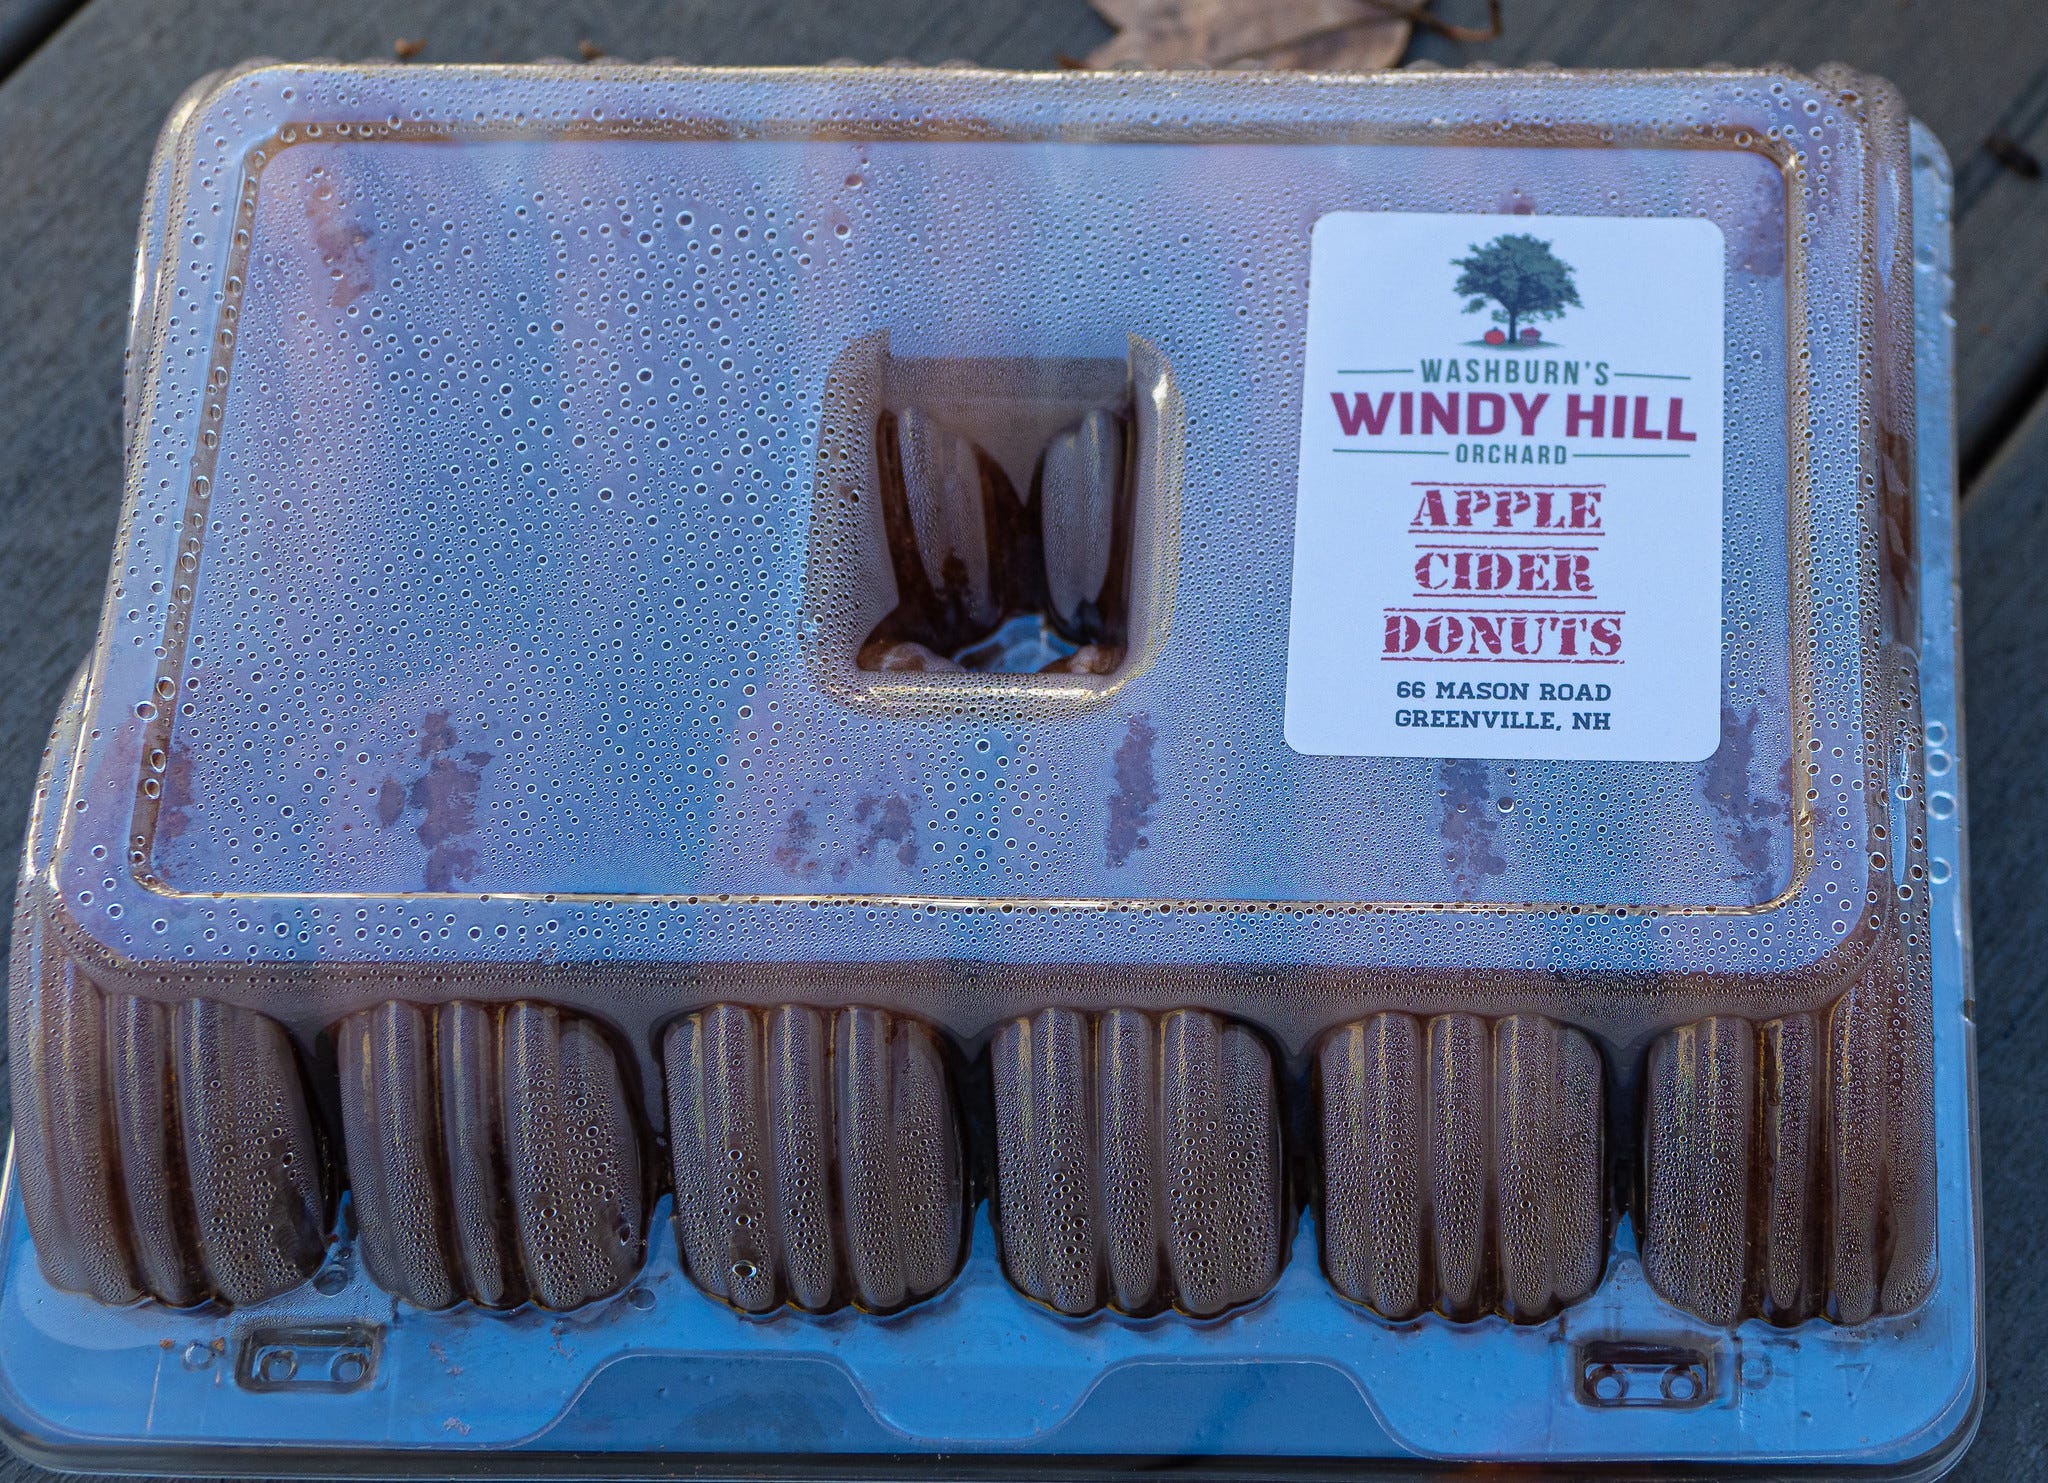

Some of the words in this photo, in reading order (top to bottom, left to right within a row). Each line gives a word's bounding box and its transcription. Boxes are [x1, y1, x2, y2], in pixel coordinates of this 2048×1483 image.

[1420, 358, 1610, 386] WASHBURN'S
[1330, 391, 1550, 436] WINDY
[1565, 393, 1697, 442] HILL
[1456, 443, 1568, 465] ORCHARD
[1410, 489, 1602, 528] APPLE
[1414, 552, 1595, 592] CIDER
[1382, 614, 1622, 656] DONUTS
[1396, 681, 1426, 699] 66
[1435, 681, 1530, 701] MASON
[1539, 683, 1612, 702] ROAD
[1395, 709, 1562, 732] GREENVILLE,
[1571, 712, 1611, 731] NH
